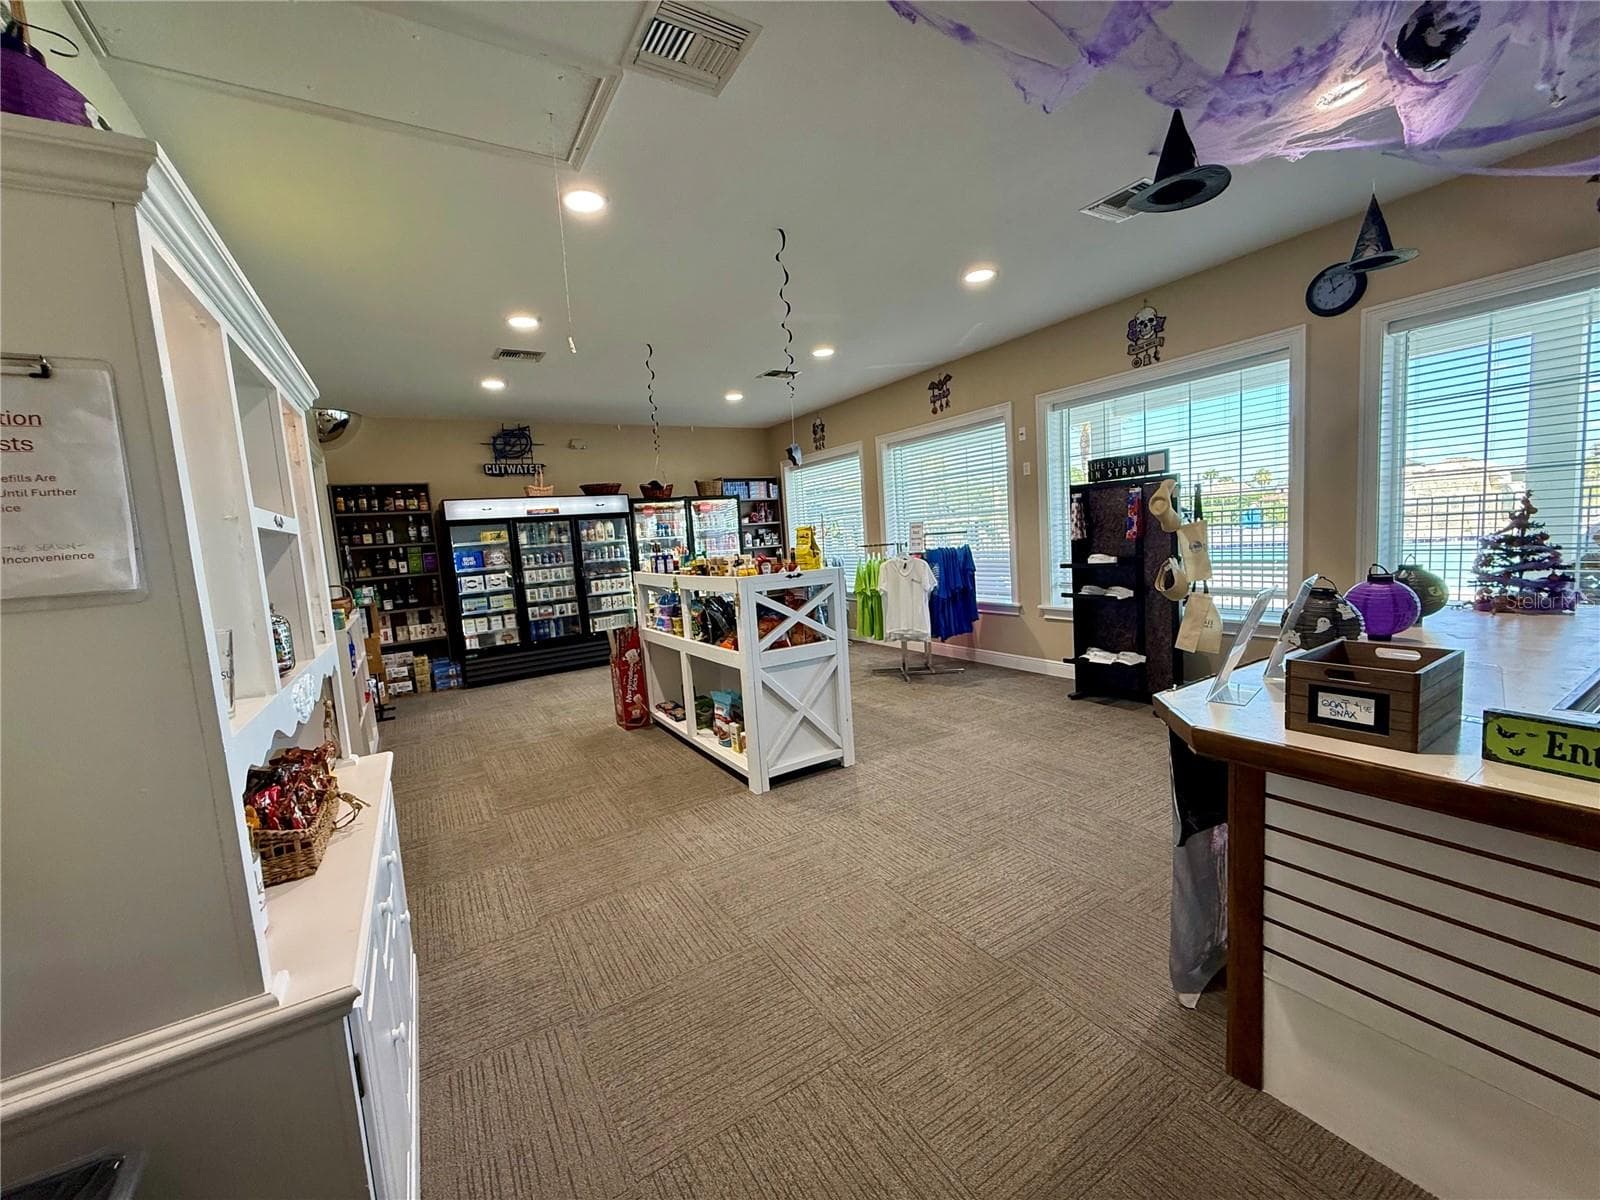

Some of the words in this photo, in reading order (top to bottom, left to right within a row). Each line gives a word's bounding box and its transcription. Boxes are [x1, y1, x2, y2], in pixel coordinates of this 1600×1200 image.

[0, 438, 33, 451] sts
[1090, 461, 1104, 471] LIFE
[1107, 460, 1115, 469] IS
[1117, 456, 1146, 467] BETTER
[35, 474, 57, 482] Are
[1090, 470, 1100, 480] IN
[1107, 465, 1146, 478] STRAW
[31, 487, 77, 497] Further
[2, 552, 95, 565] Inconvenience
[1329, 708, 1358, 720] SNAX
